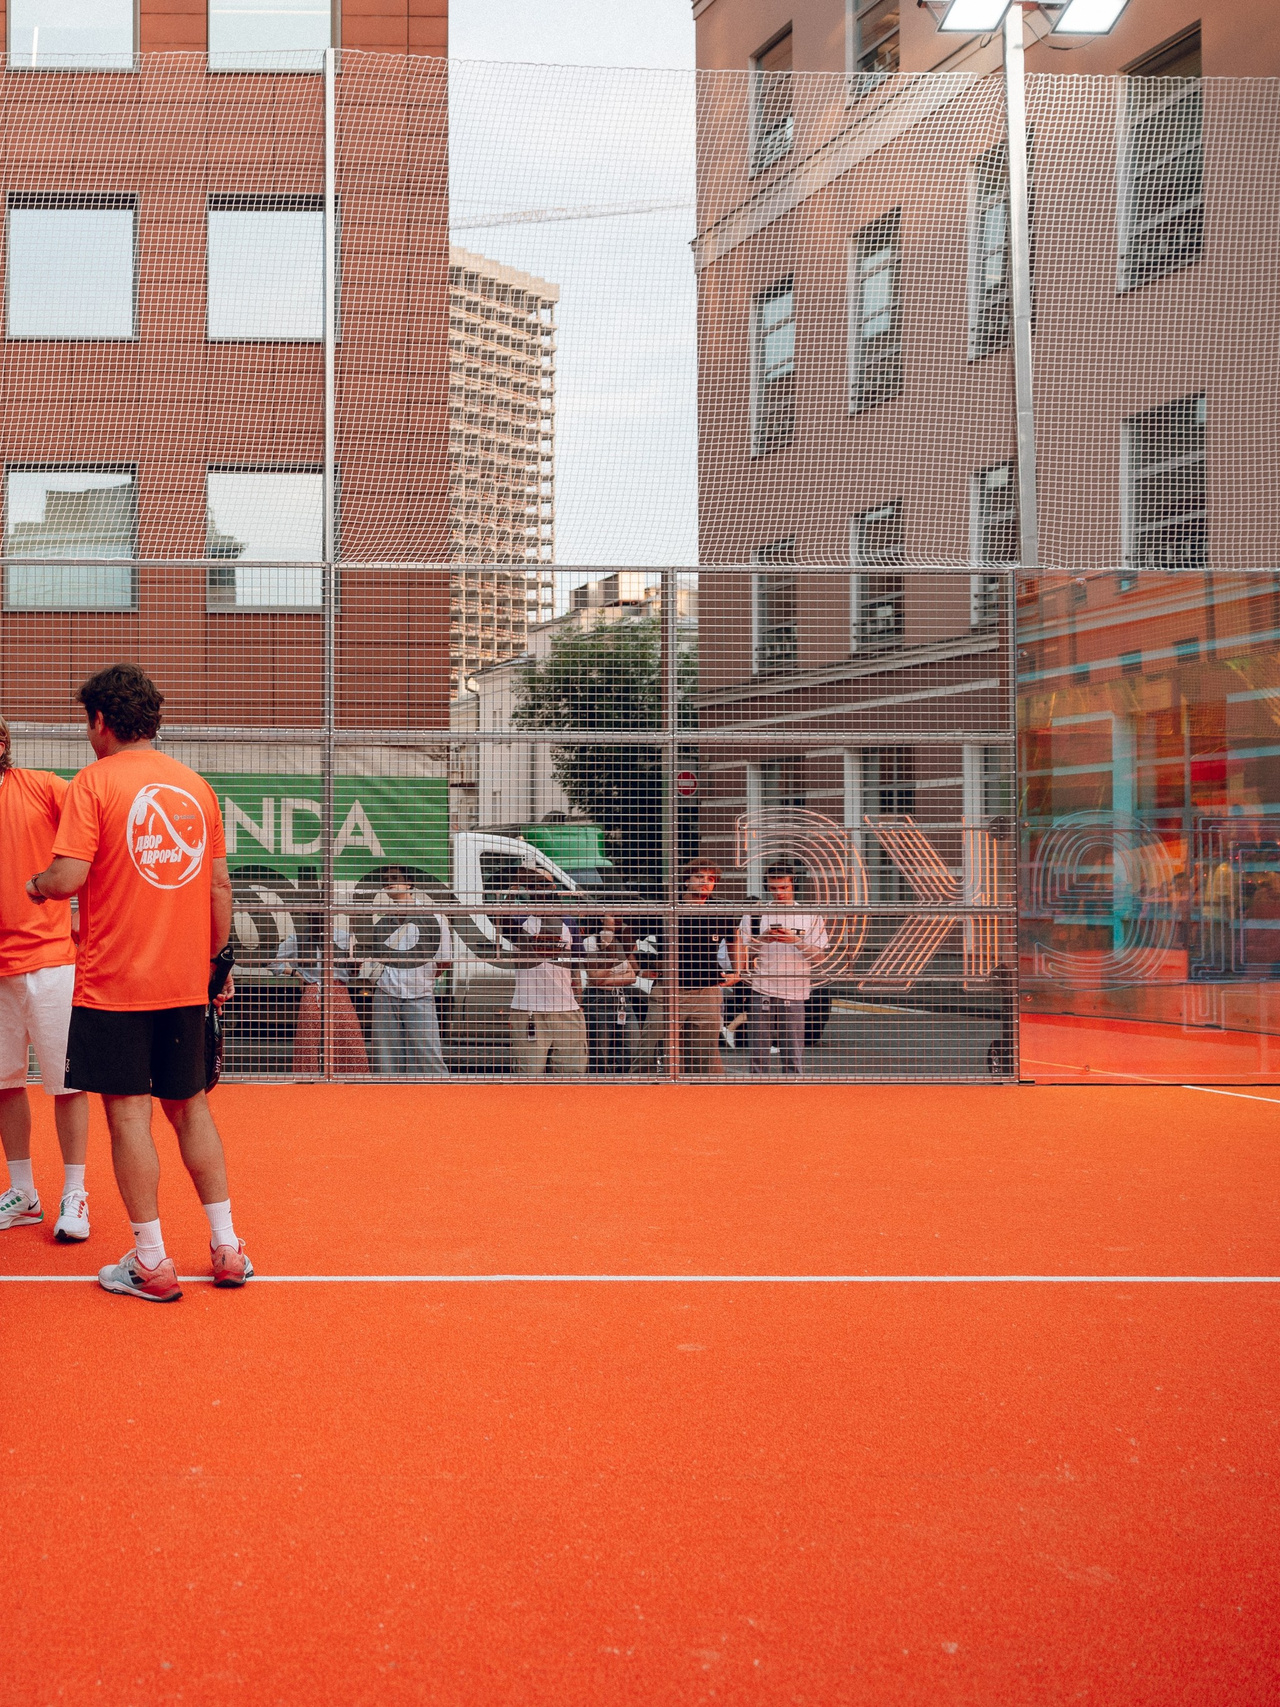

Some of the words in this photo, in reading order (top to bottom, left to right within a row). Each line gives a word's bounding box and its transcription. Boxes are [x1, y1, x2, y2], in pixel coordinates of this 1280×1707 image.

[225, 797, 385, 857] NDA
[135, 835, 163, 853] ДВОР
[140, 847, 182, 865] АВРОРЫ
